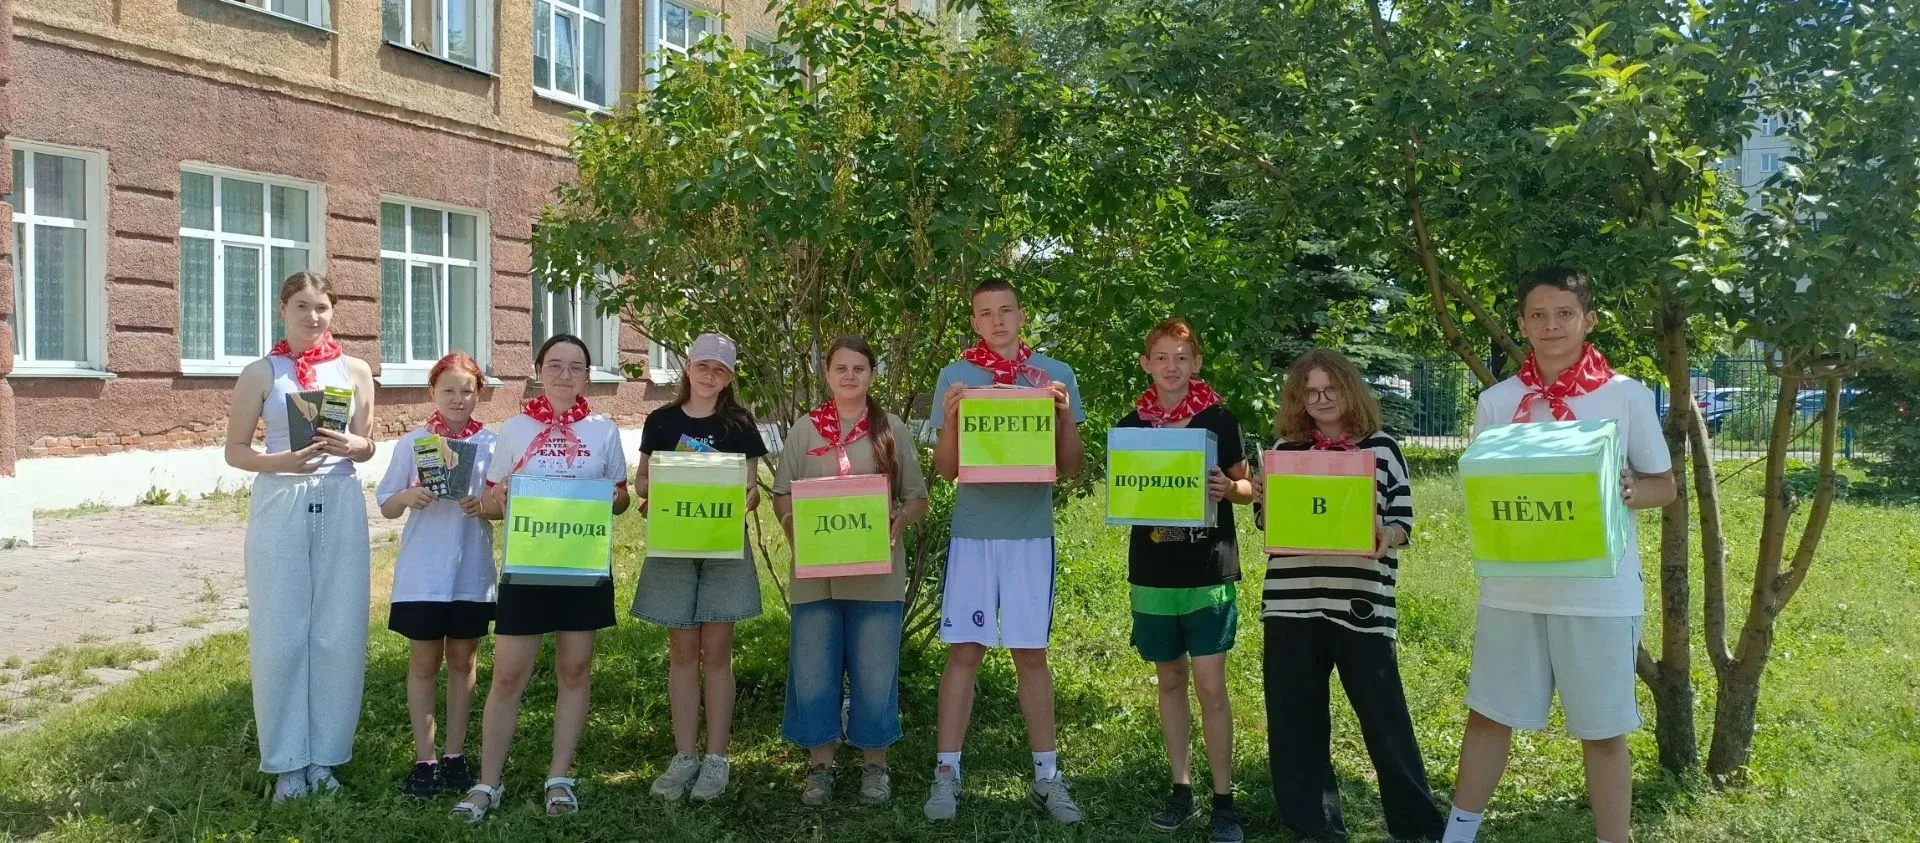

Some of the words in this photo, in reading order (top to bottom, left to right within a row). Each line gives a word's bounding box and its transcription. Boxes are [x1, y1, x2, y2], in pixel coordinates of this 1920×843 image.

[963, 415, 1053, 432] БЕРЕГИ
[1114, 474, 1199, 491] порядок
[675, 501, 733, 518] НАШ
[1311, 497, 1327, 514] В
[1489, 495, 1575, 521] НЁМ!
[513, 515, 606, 539] Природа
[814, 513, 872, 535] ДОМ,
